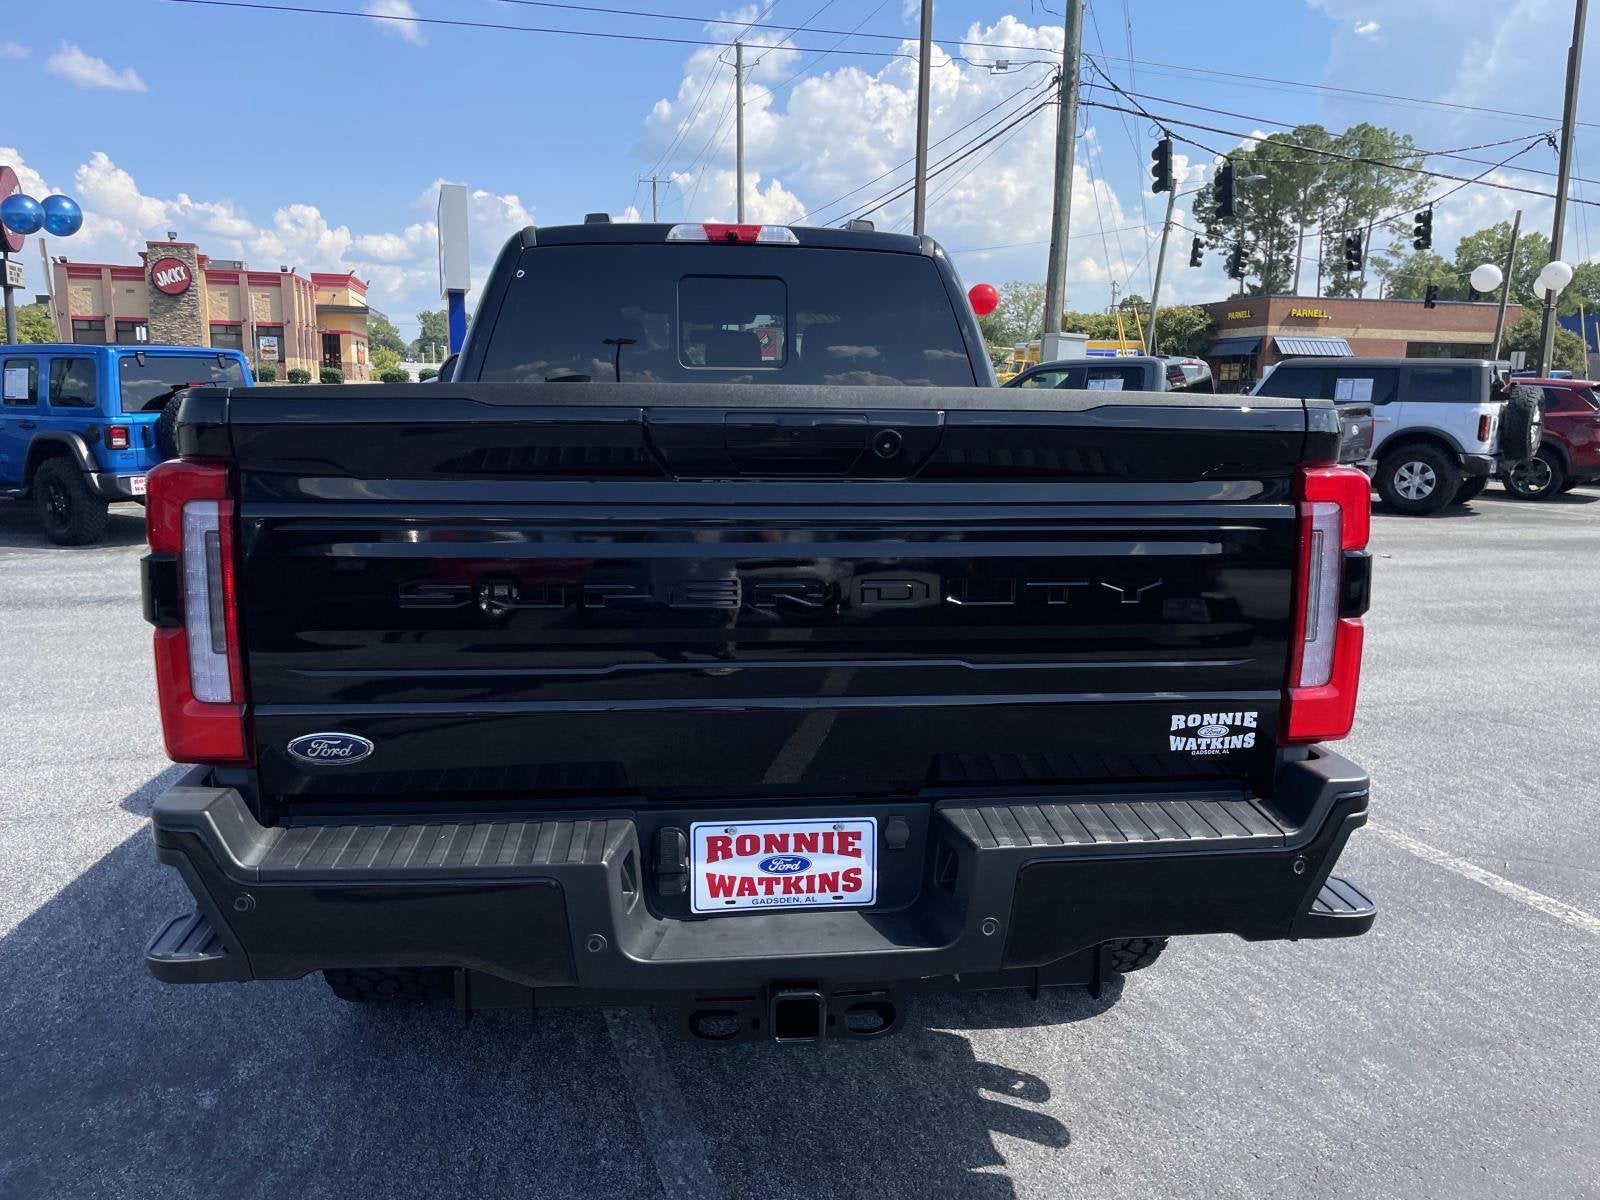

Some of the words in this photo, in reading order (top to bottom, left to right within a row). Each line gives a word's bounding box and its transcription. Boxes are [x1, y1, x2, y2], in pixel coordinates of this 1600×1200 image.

[1227, 310, 1252, 320] PARNELL
[1291, 308, 1328, 318] PARNELL
[398, 576, 832, 613] SUPER
[860, 575, 1164, 606] DUTY
[1170, 711, 1258, 731] RONNIE
[1169, 732, 1256, 751] WATKINS
[706, 831, 862, 864] RONNIE
[706, 867, 863, 899] WATKINS
[751, 897, 802, 906] GADSDEN,
[804, 896, 817, 904] AL
